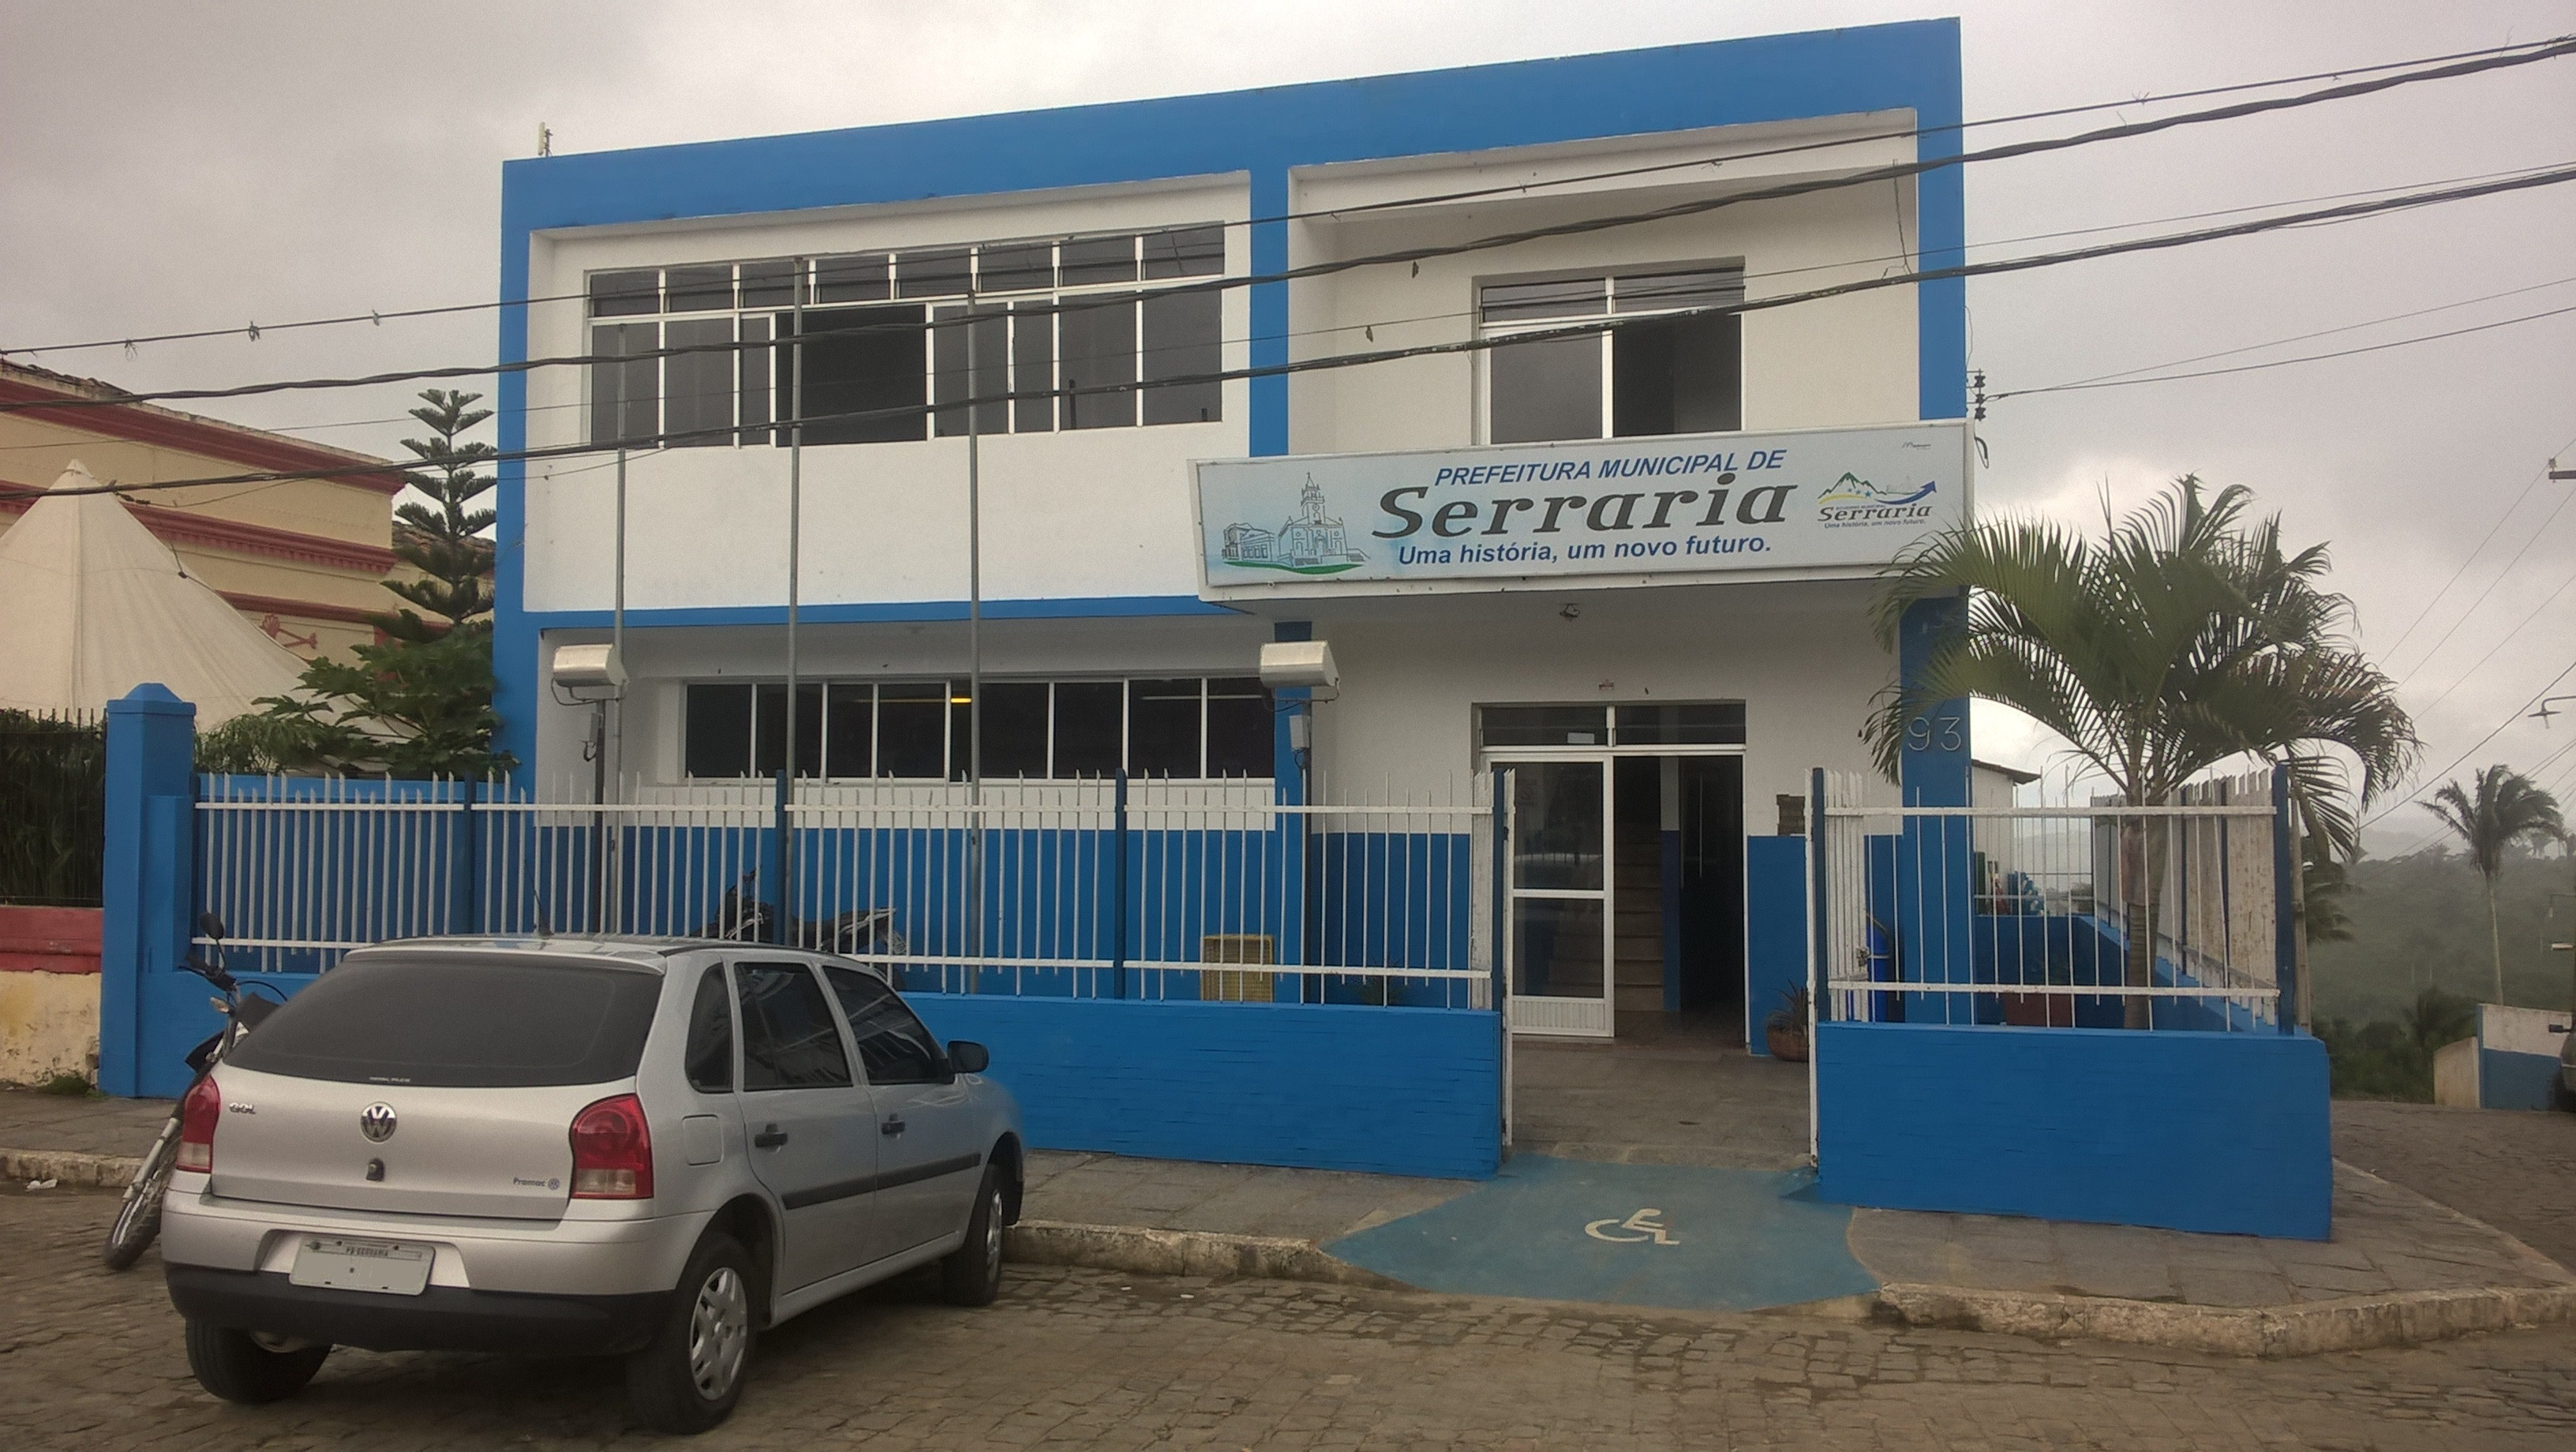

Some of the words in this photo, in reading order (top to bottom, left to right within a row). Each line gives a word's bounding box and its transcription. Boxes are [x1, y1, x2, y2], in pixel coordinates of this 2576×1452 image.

[1434, 460, 1591, 486] PREFEITURA
[1597, 451, 1739, 479] MUNICIPAL
[1746, 448, 1788, 471] DE
[1371, 472, 1799, 539] Serraria
[1817, 503, 1934, 522] Serraria
[1398, 545, 1451, 565] Uma
[1459, 541, 1558, 563] história,
[1567, 543, 1605, 559] um
[1613, 540, 1678, 558] novo
[1685, 534, 1772, 556] futuro.
[1908, 716, 1962, 751] 93
[229, 1102, 256, 1115] GOL
